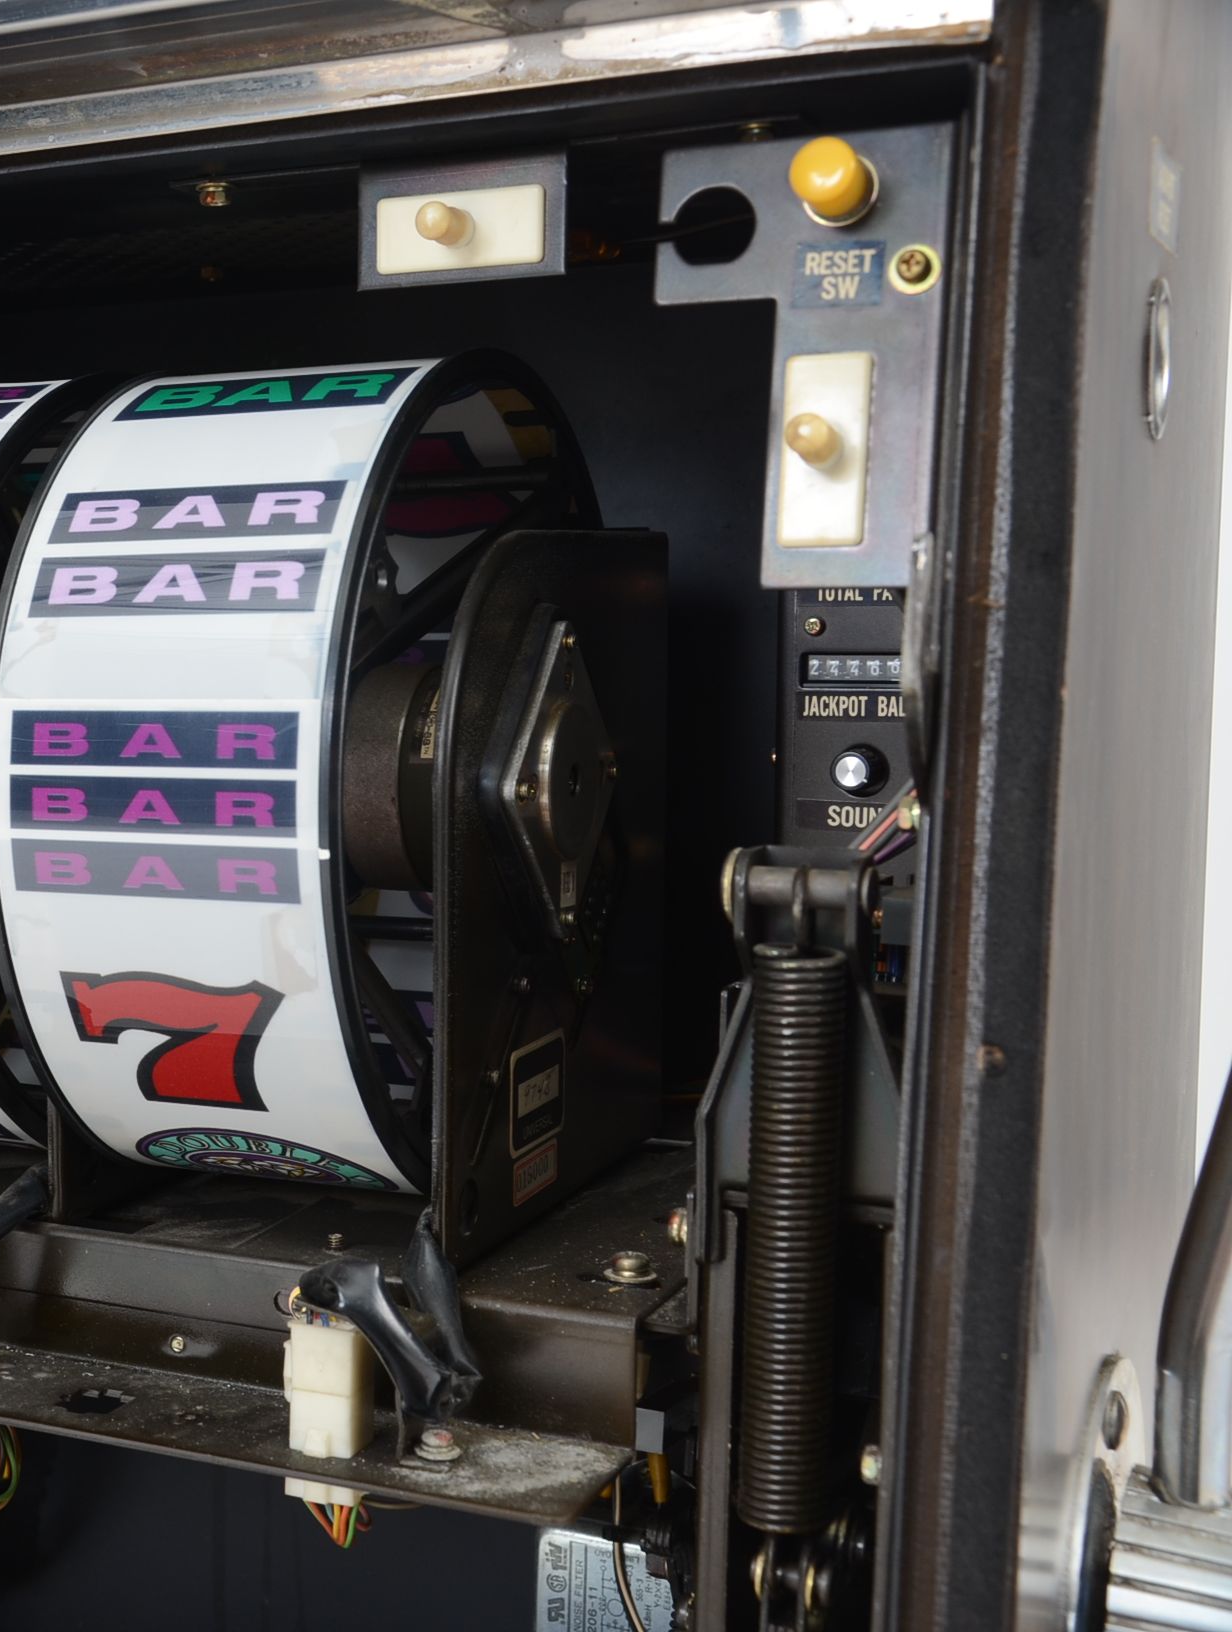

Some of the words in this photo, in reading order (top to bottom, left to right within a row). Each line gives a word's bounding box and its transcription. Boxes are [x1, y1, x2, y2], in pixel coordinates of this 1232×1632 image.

[804, 250, 877, 276] RESET
[821, 276, 860, 300] SW
[134, 373, 396, 413] BAR
[68, 490, 326, 534] BAR
[47, 560, 306, 605] BAR
[802, 695, 869, 717] JACKPOT
[877, 695, 907, 717] BAL
[31, 722, 278, 760] BAR
[31, 786, 276, 828] BAR
[827, 805, 883, 828] SOUN
[33, 851, 279, 895] BAR
[59, 970, 286, 1112] 7
[153, 1134, 348, 1171] DOUBLE
[574, 1560, 583, 1597] FILTER
[573, 1601, 583, 1632] NOISE
